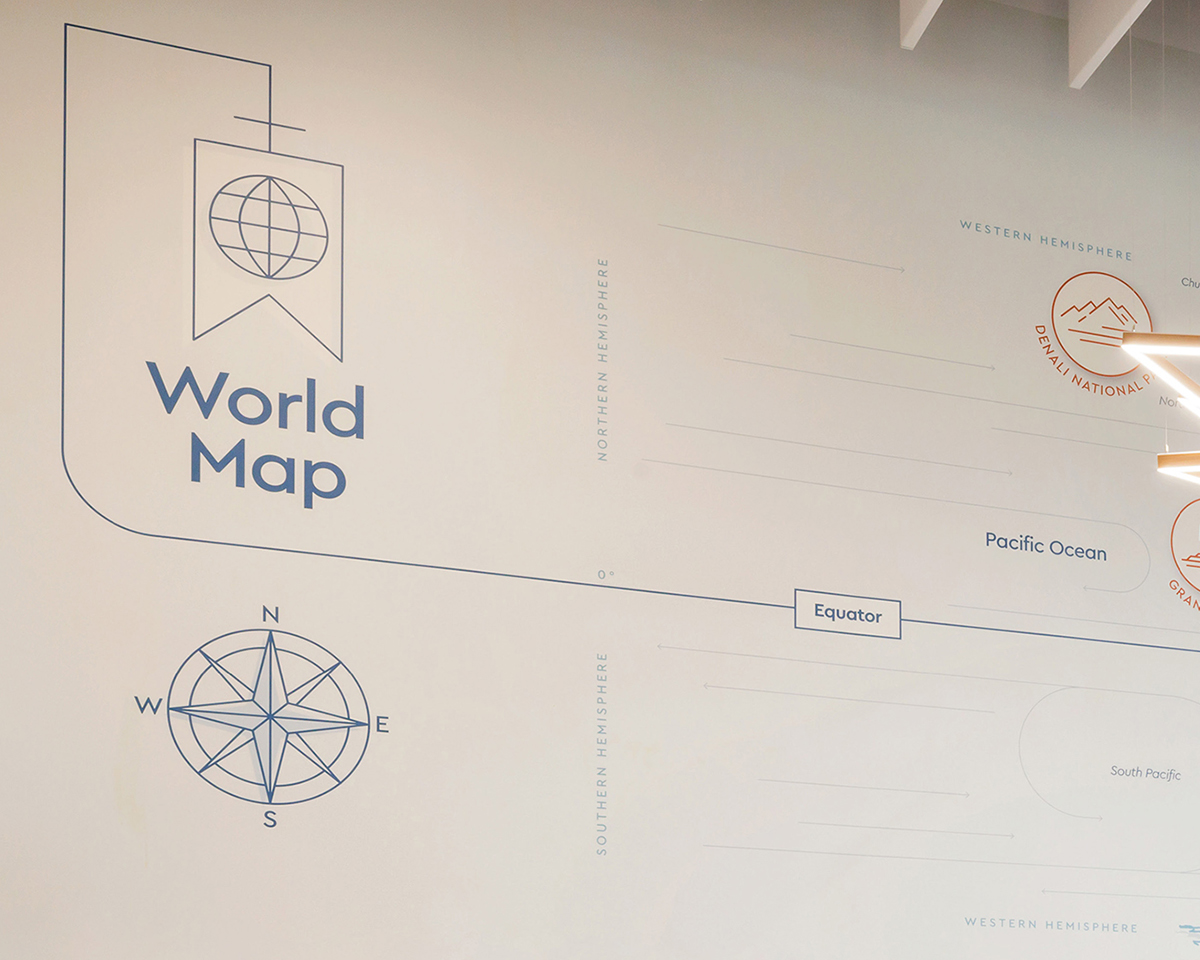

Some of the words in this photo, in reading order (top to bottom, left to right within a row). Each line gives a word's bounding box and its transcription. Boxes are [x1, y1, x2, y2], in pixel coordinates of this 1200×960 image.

[959, 219, 1032, 242] WESTERN
[1040, 235, 1133, 262] HEMISPHERE
[597, 257, 609, 364] HEMISPHERE
[1034, 324, 1070, 376] DENALI
[1070, 374, 1144, 398] NATIONAL
[145, 361, 366, 440] World
[597, 371, 610, 463] NORTHERN
[190, 431, 348, 510] Map
[985, 531, 1046, 554] Pacific
[1049, 539, 1108, 562] Ocean
[263, 606, 280, 624] N
[813, 603, 883, 625] Equator
[134, 696, 163, 716] W
[596, 651, 608, 759] HEMISPHERE
[377, 716, 390, 733] E
[1110, 764, 1143, 778] South
[1145, 767, 1182, 782] Pacific
[263, 810, 278, 829] S
[595, 766, 608, 857] SOUTHERN
[964, 916, 1037, 929] WESTERN
[1045, 920, 1138, 934] HEMISPHERE
